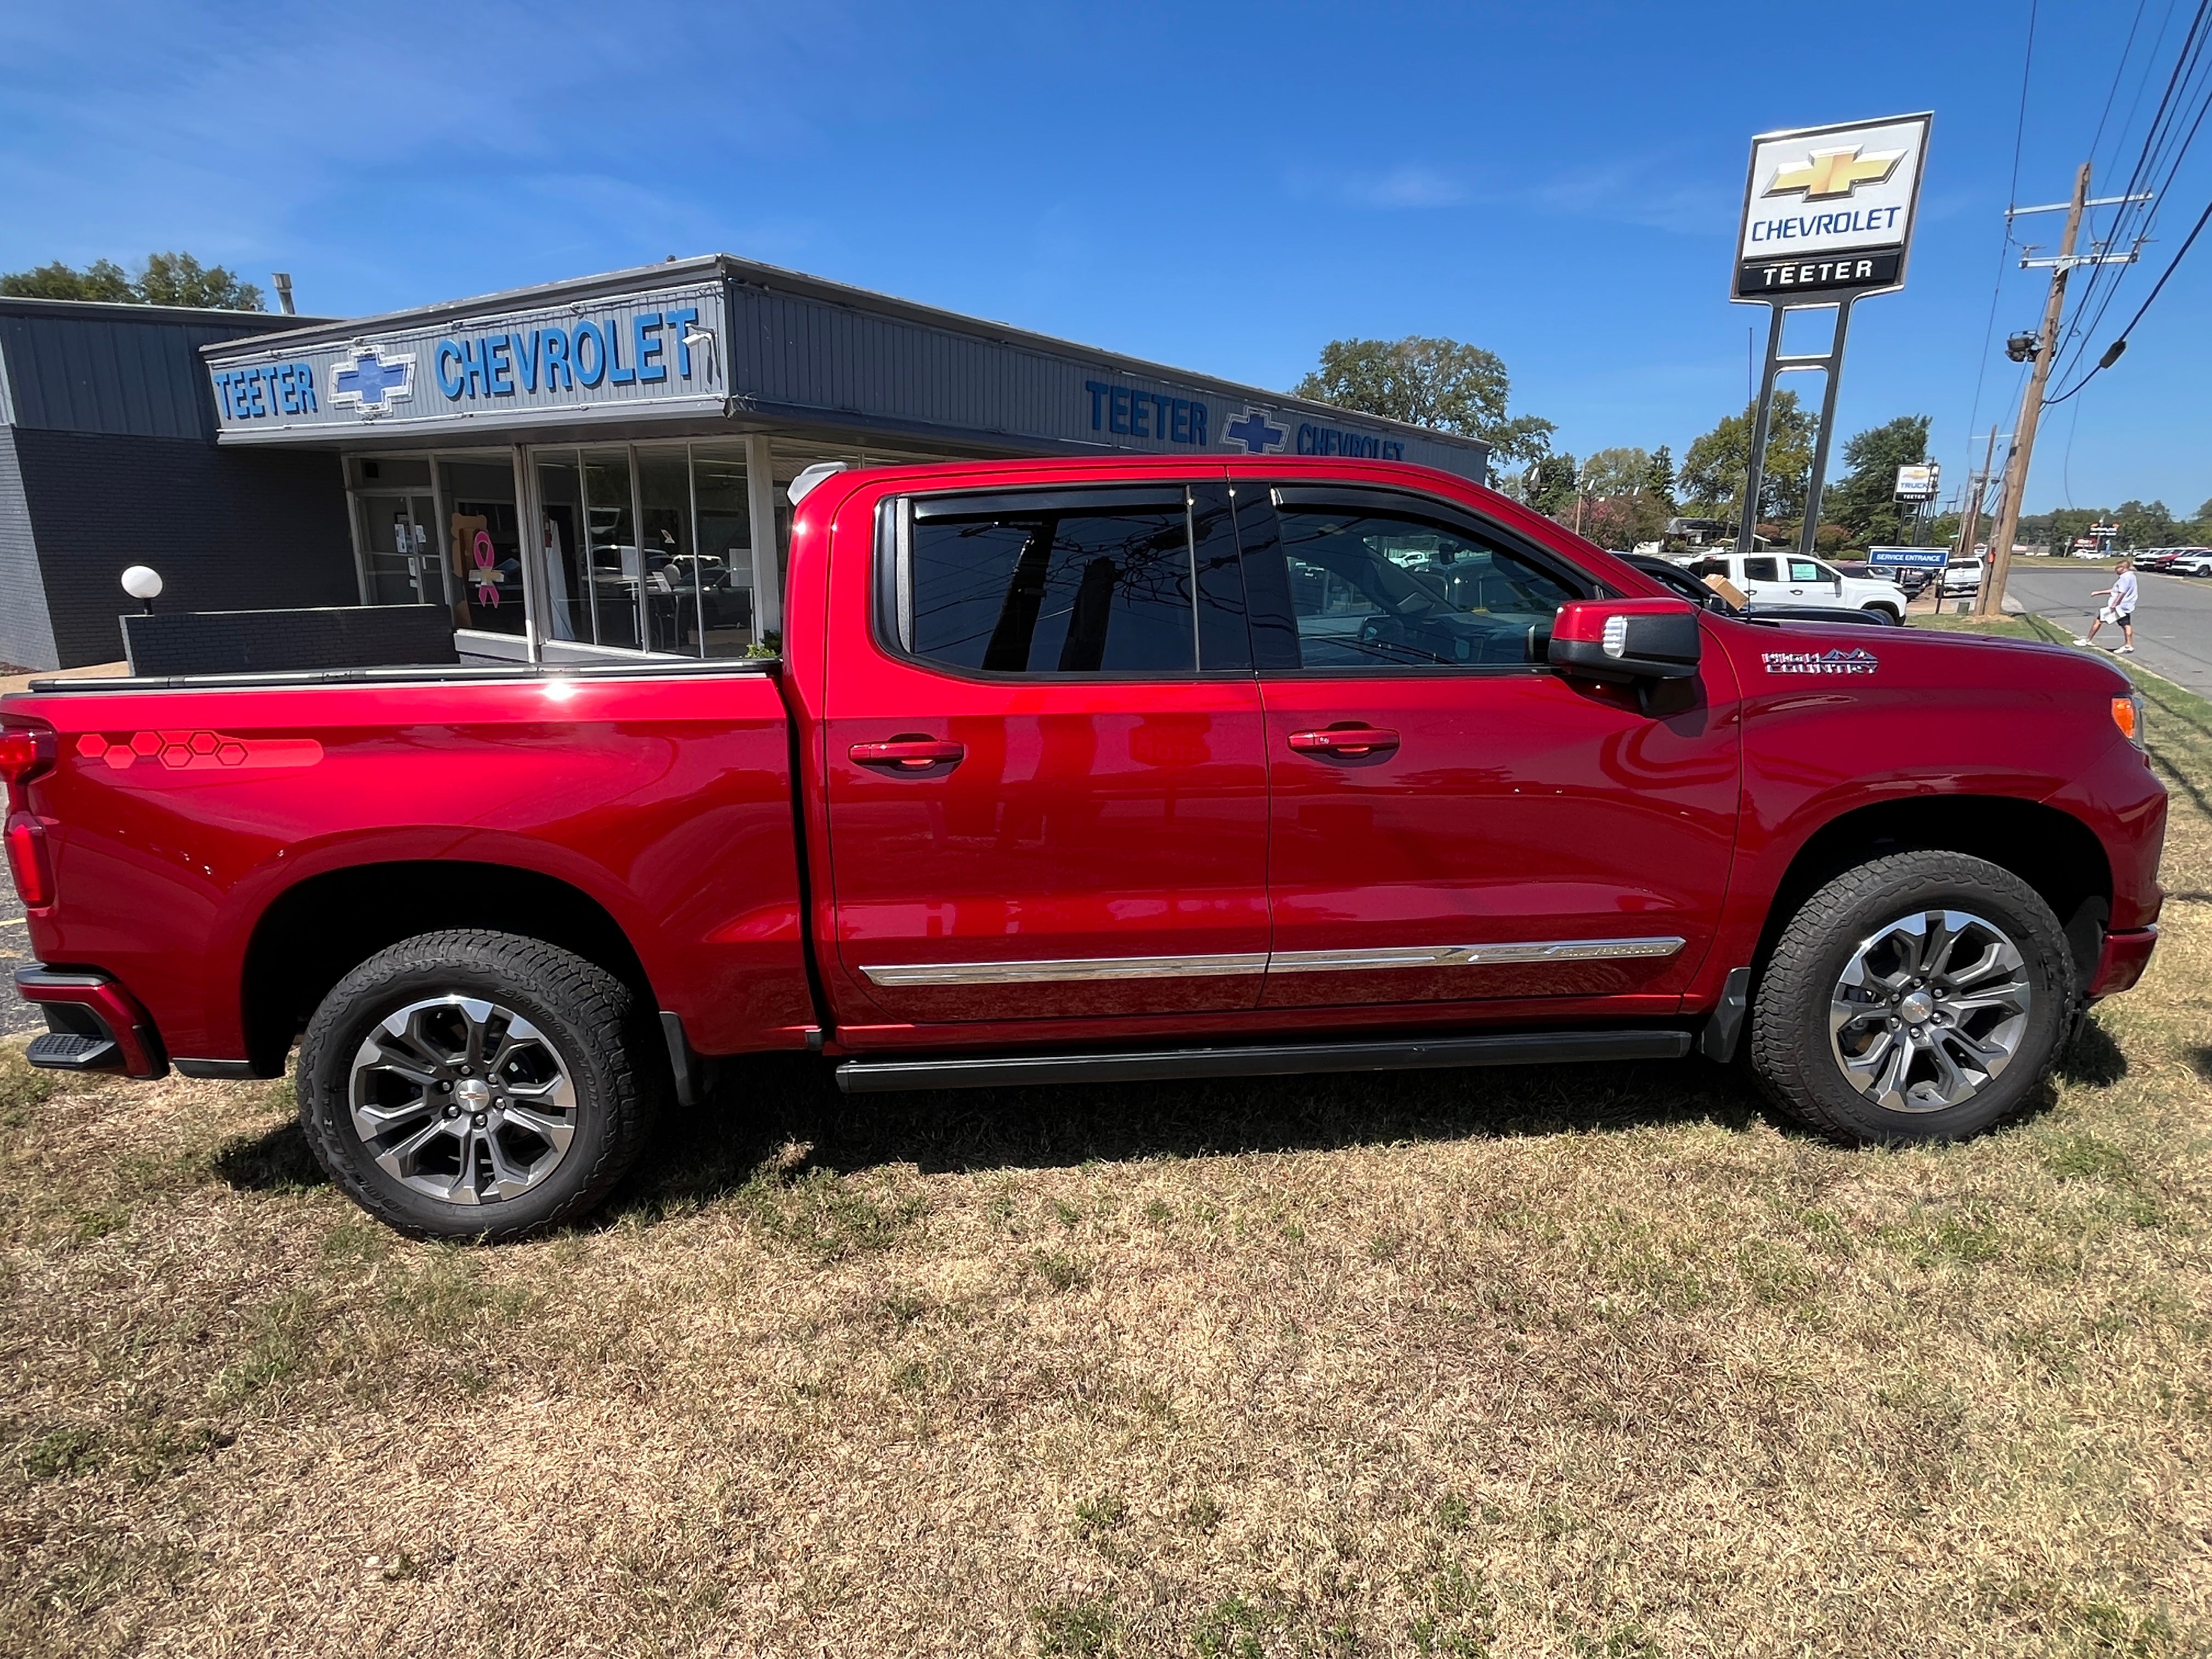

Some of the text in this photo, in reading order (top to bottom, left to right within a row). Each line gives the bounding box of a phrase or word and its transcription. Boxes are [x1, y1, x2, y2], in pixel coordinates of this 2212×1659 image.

[1752, 206, 1901, 241] CHEVROLET
[1763, 260, 1873, 285] TEETER
[213, 308, 699, 420] TEETER CHEVROLET
[1086, 380, 1207, 446] TEETER
[1765, 664, 1877, 674] COUNTRY
